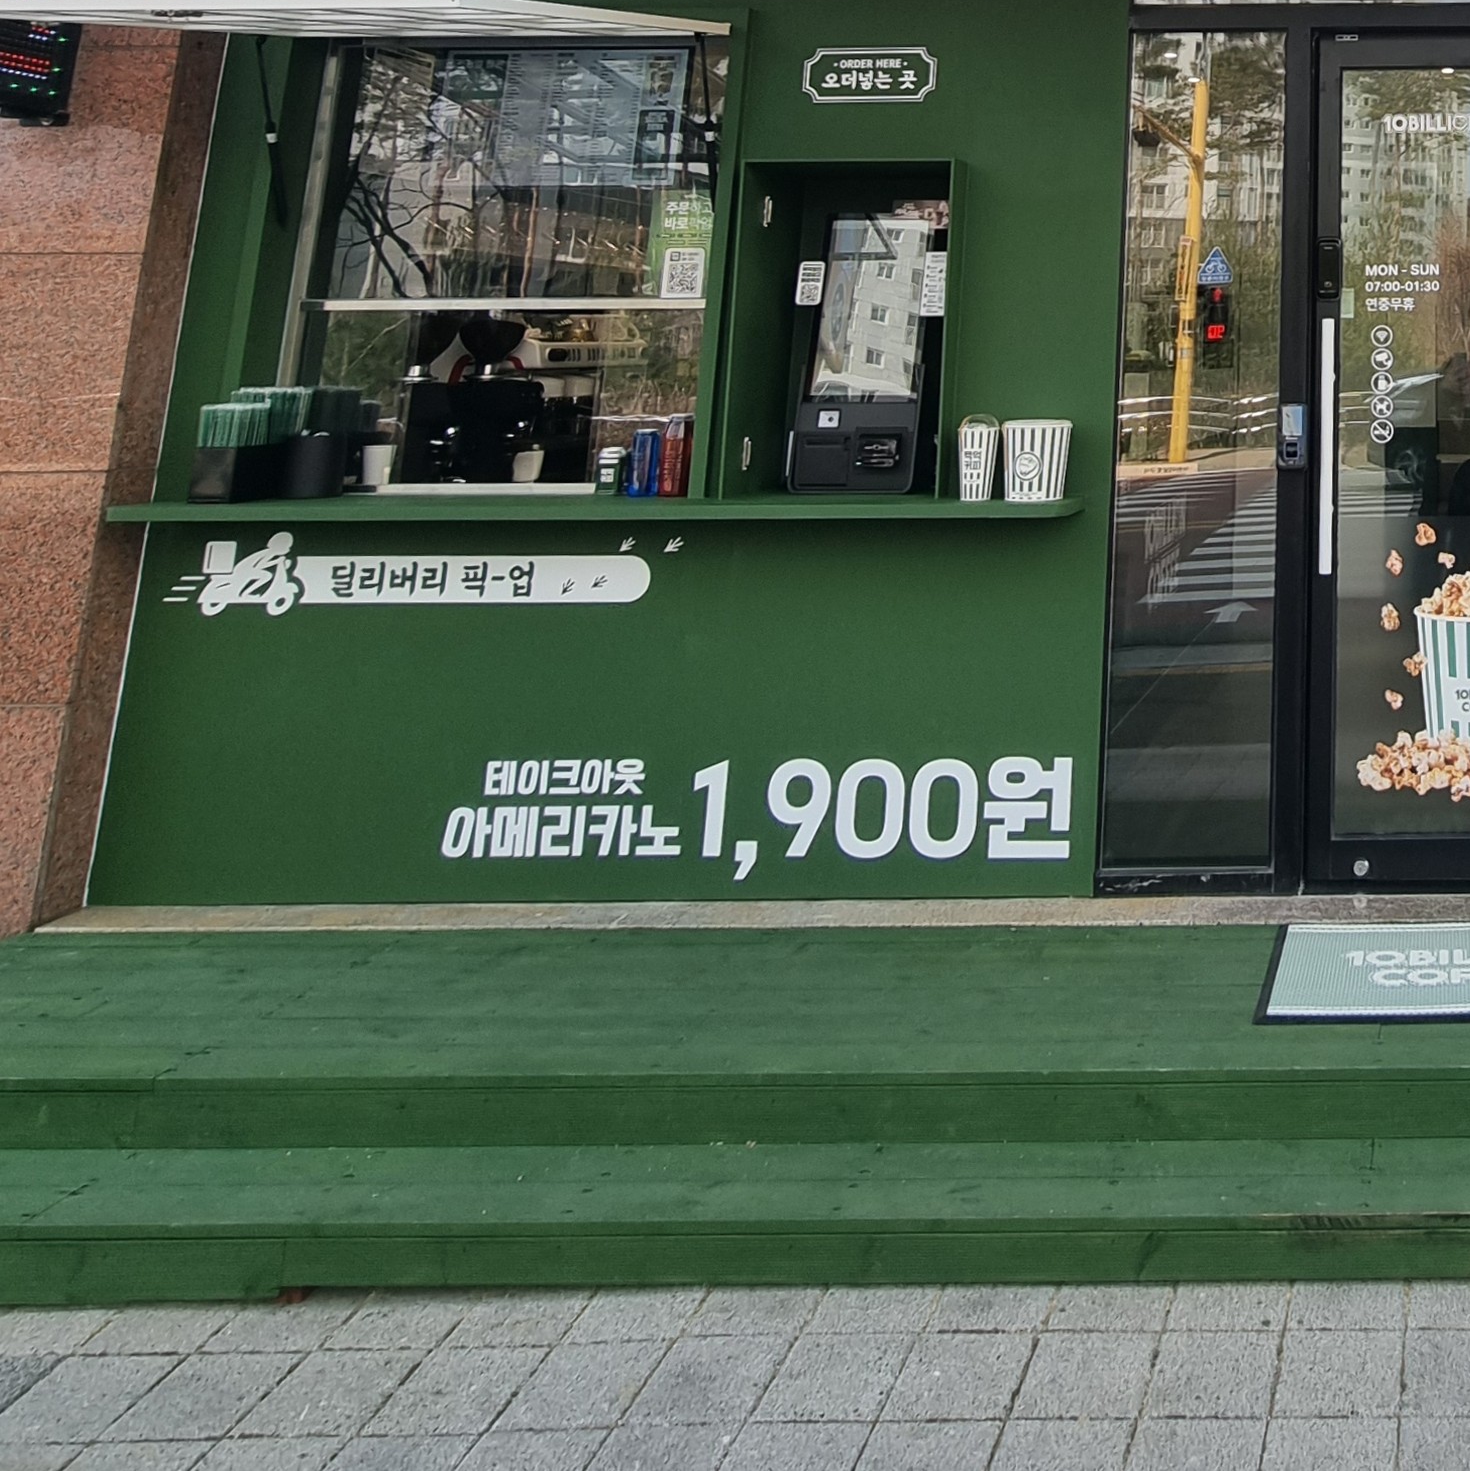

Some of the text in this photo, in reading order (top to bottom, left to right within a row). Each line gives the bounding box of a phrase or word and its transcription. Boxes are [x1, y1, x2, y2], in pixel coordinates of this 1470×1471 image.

[840, 58, 902, 69] ORDER HERE
[821, 70, 918, 90] 오더넣는 곳
[1365, 264, 1398, 276] MON
[1410, 264, 1440, 276] SUN
[1365, 281, 1440, 292] 07:00-01:30
[1365, 297, 1415, 311] 연중무휴
[330, 561, 535, 598] 딜리버리 픽-업
[484, 758, 646, 797] 테이크아웃
[441, 755, 1074, 882] 아메리카노 1,900원
